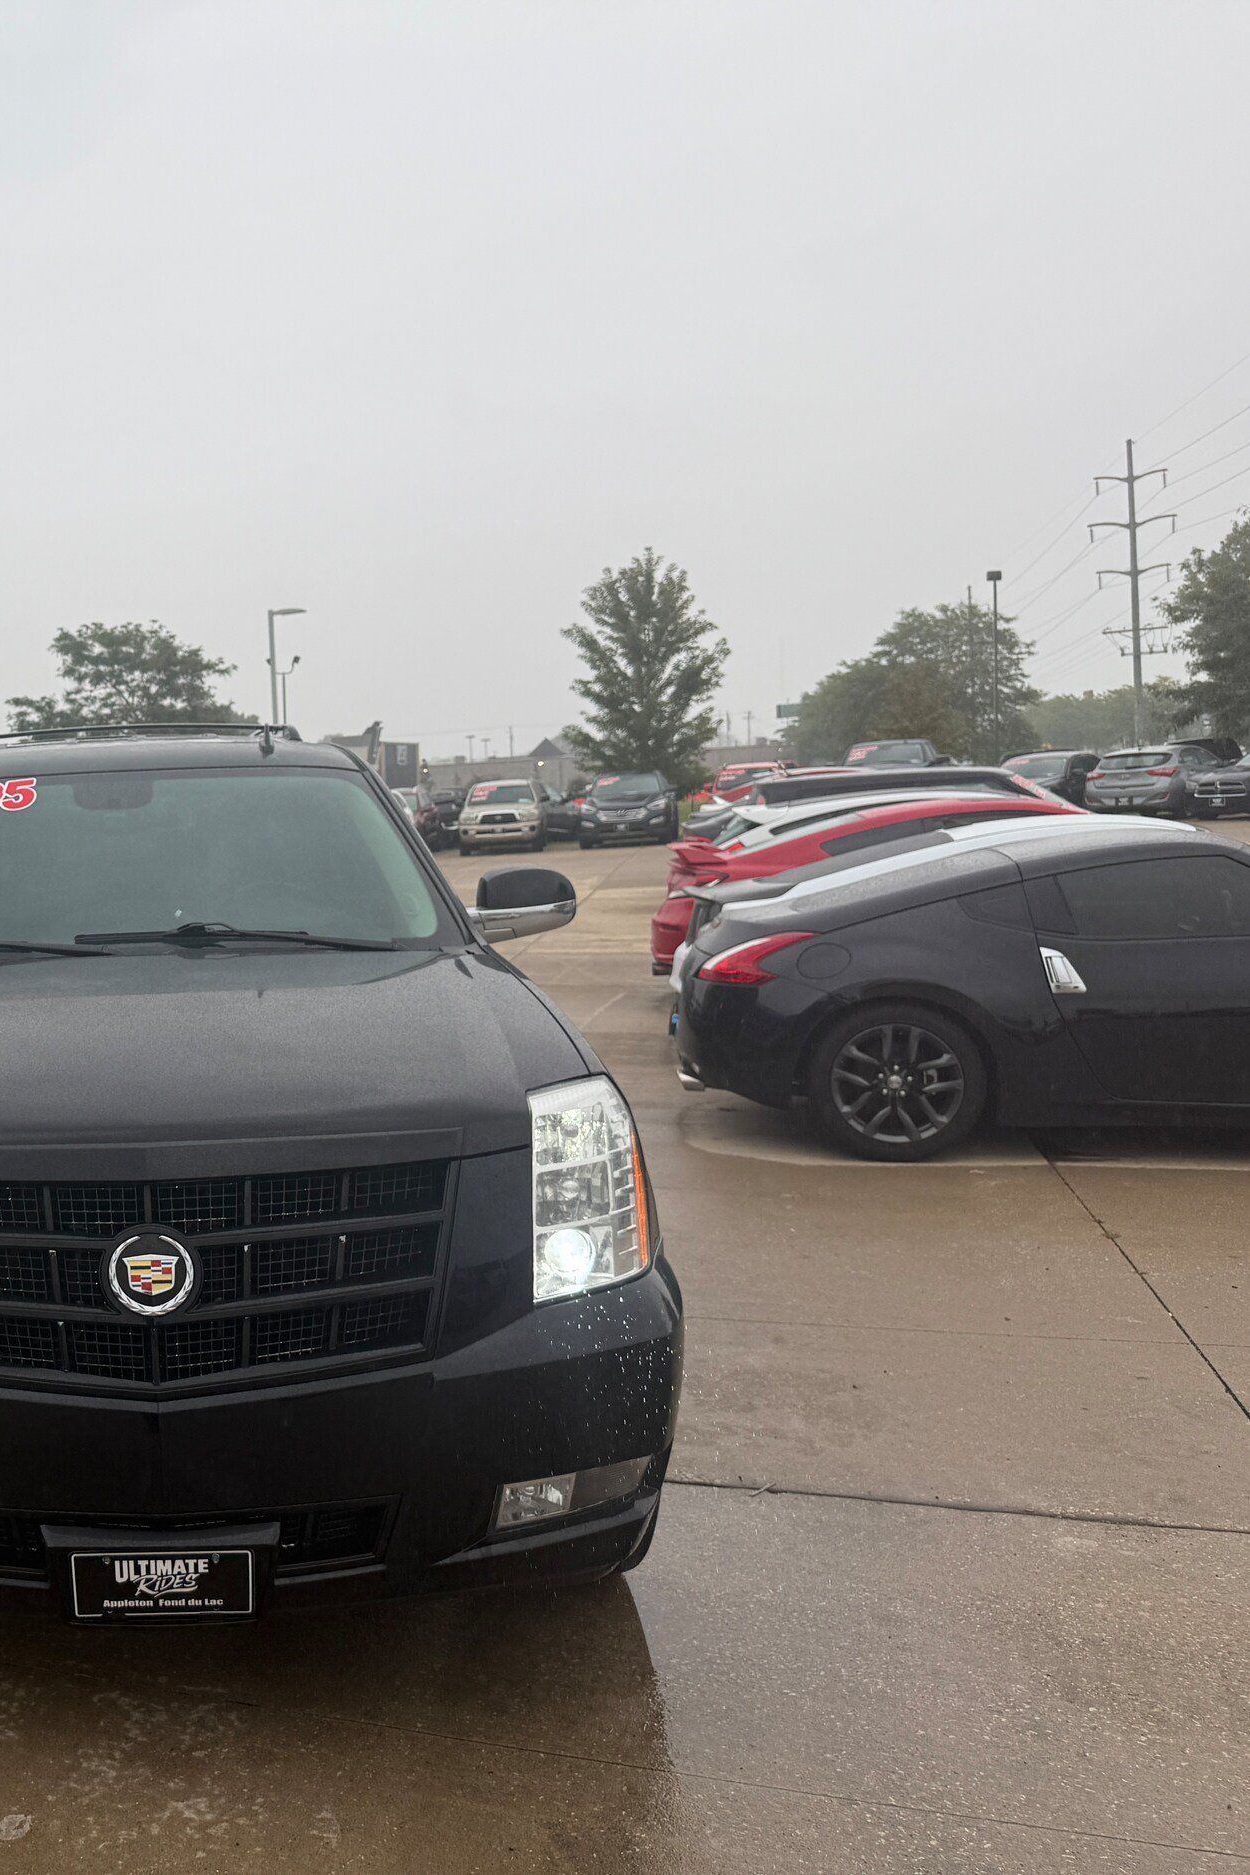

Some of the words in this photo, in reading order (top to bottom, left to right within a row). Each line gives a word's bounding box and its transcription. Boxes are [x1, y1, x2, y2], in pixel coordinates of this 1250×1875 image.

[114, 1558, 209, 1583] ULTIMATE
[103, 1599, 153, 1608] Appleton
[158, 1598, 185, 1607] Fond
[204, 1598, 223, 1606] Lac
